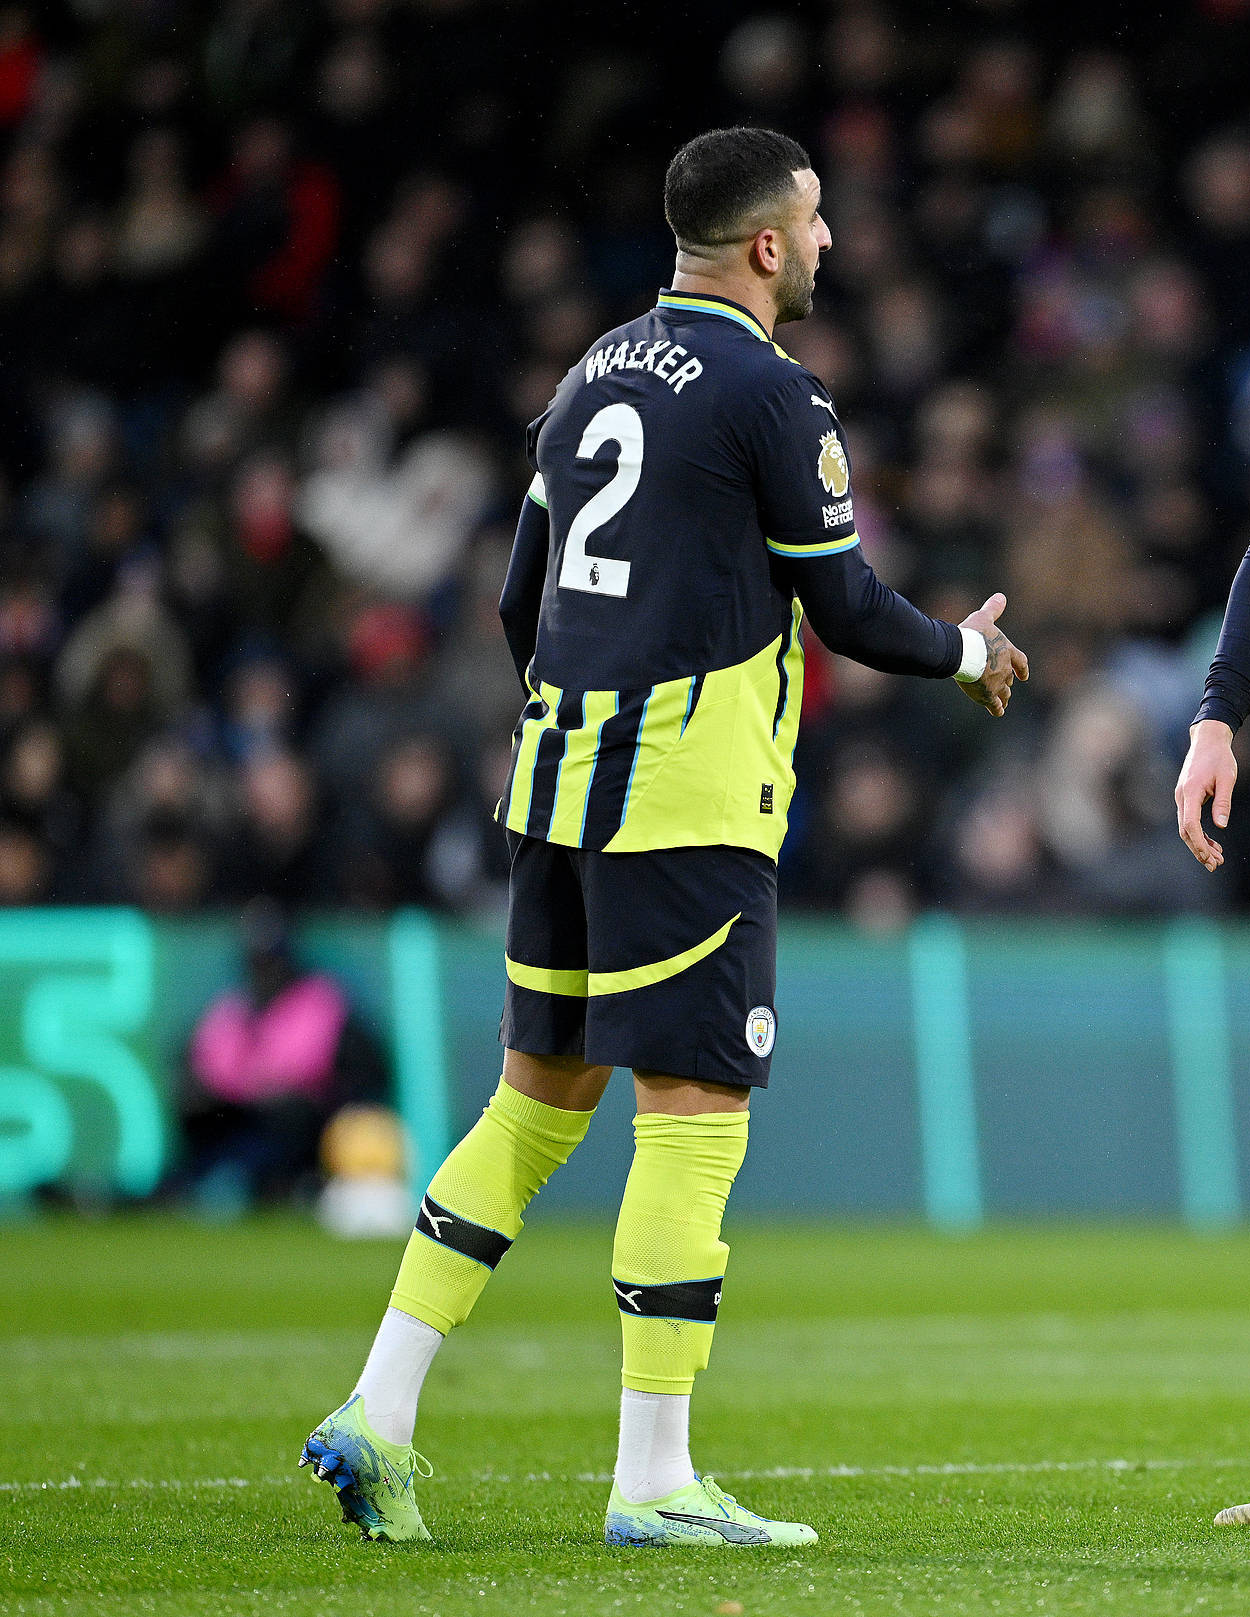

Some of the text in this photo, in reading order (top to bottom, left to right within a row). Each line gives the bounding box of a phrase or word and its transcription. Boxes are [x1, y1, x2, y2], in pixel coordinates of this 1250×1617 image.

[585, 339, 704, 395] WALKER
[557, 402, 645, 598] 2
[822, 504, 838, 517] No
